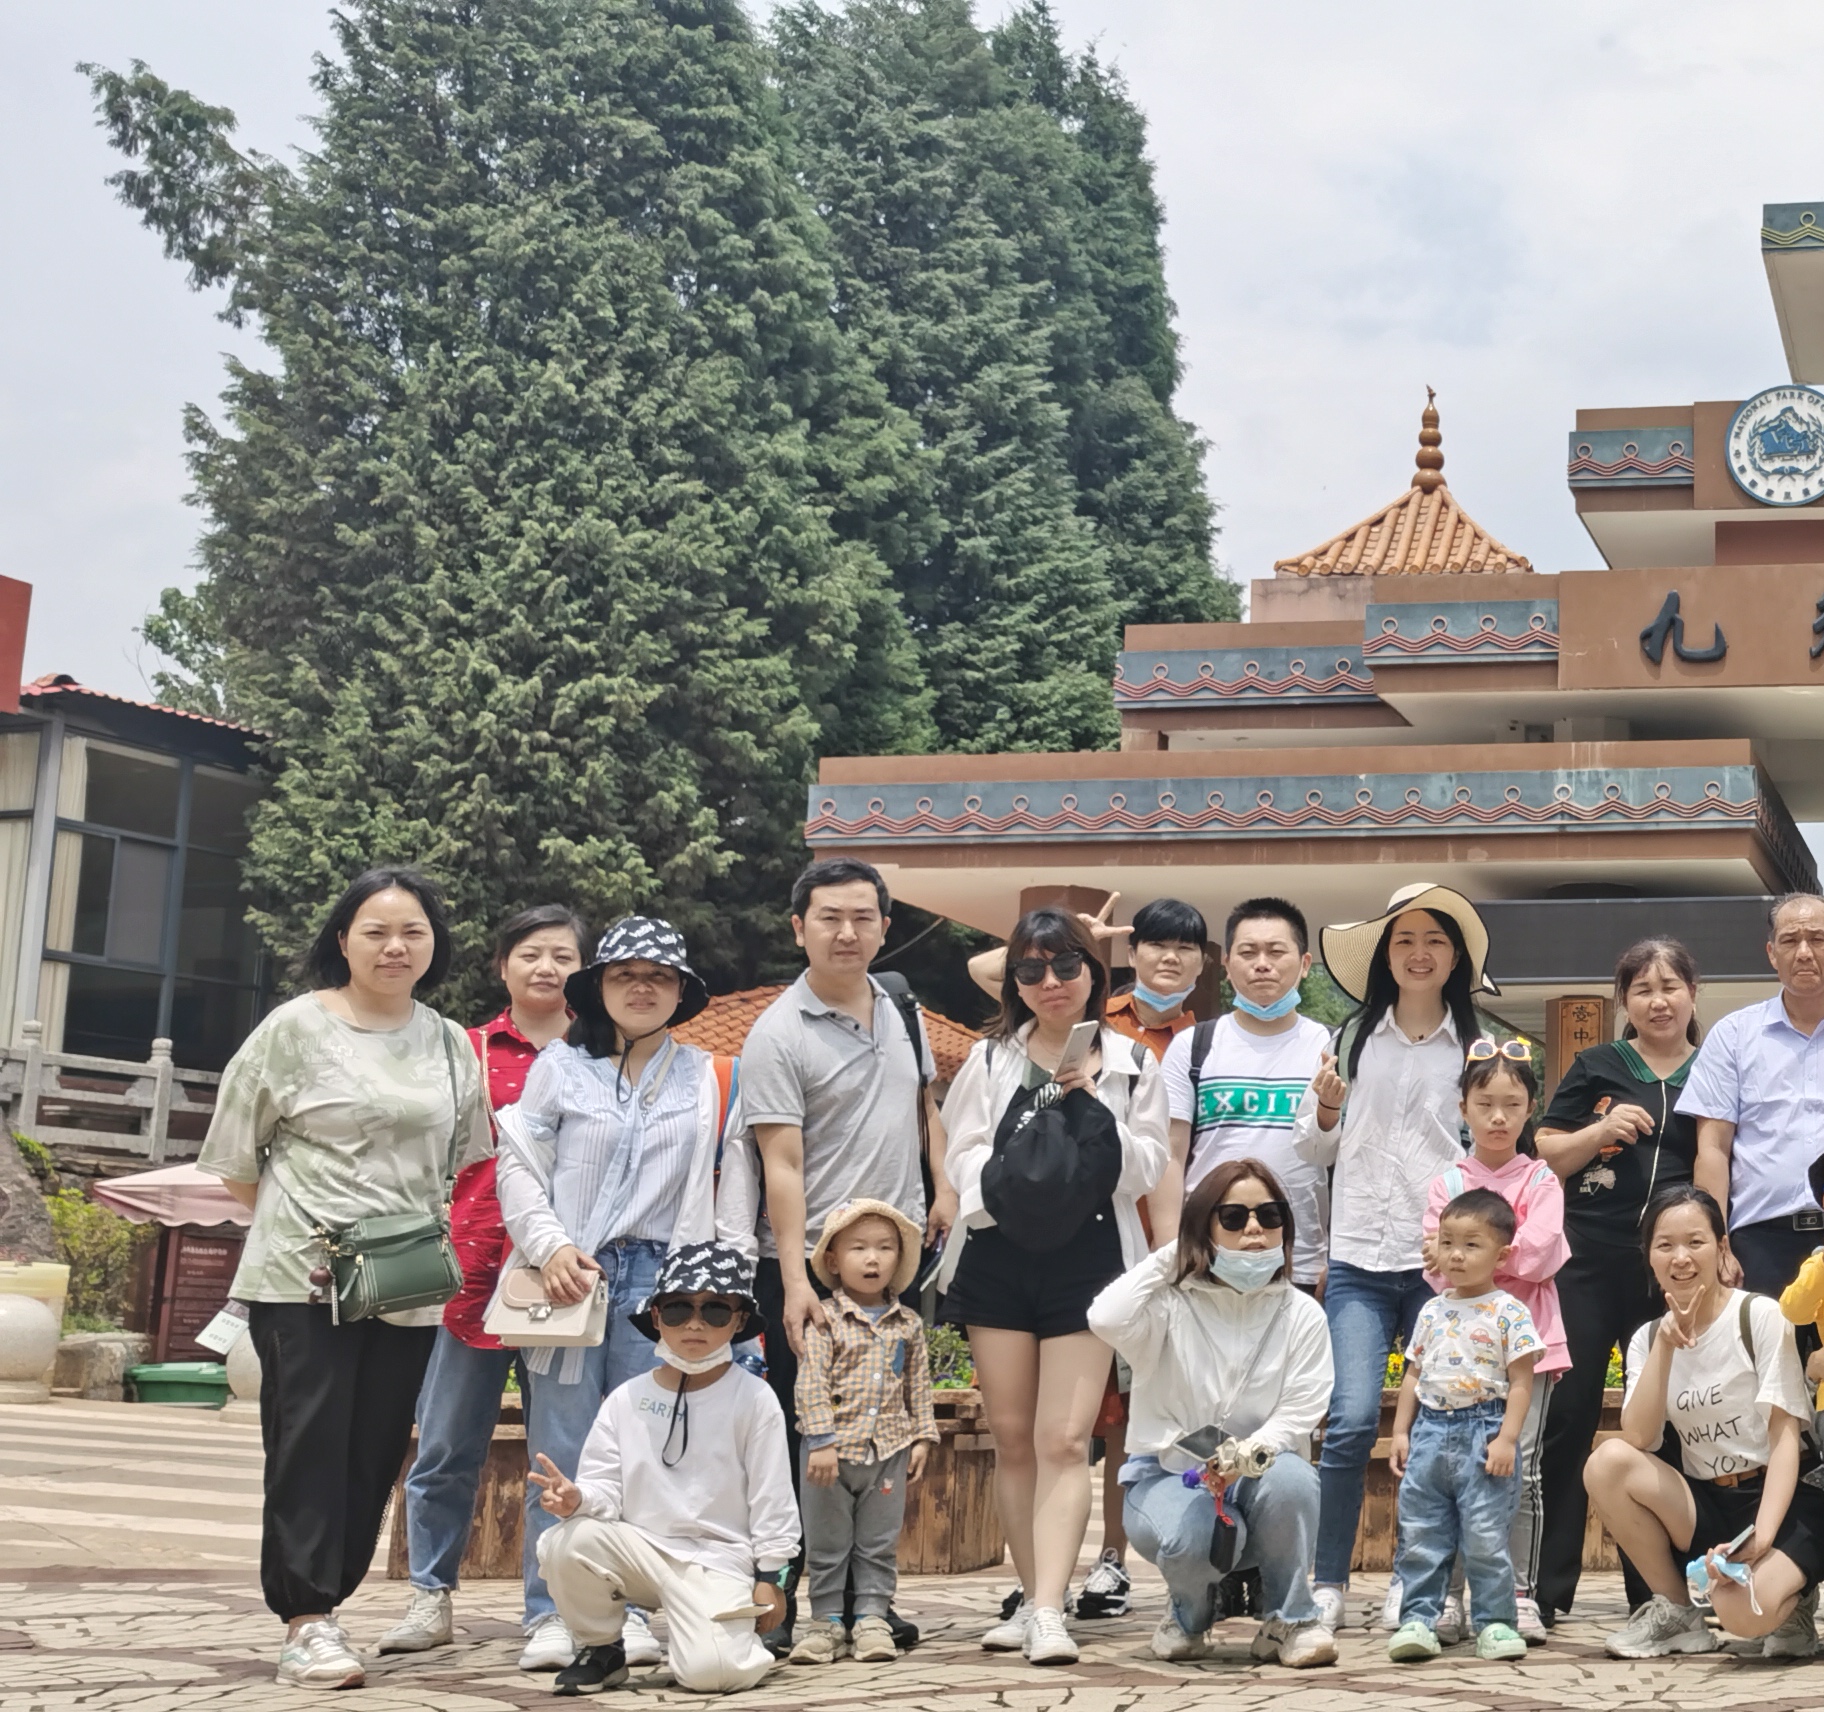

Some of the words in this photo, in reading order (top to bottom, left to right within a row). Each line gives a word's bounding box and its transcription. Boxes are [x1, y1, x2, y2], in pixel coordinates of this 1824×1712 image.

[1733, 395, 1772, 440] NATIONAL
[1775, 391, 1805, 401] PARK
[1807, 395, 1821, 406] OF
[1676, 1383, 1723, 1412] GIVE
[1678, 1415, 1742, 1446] WHAT
